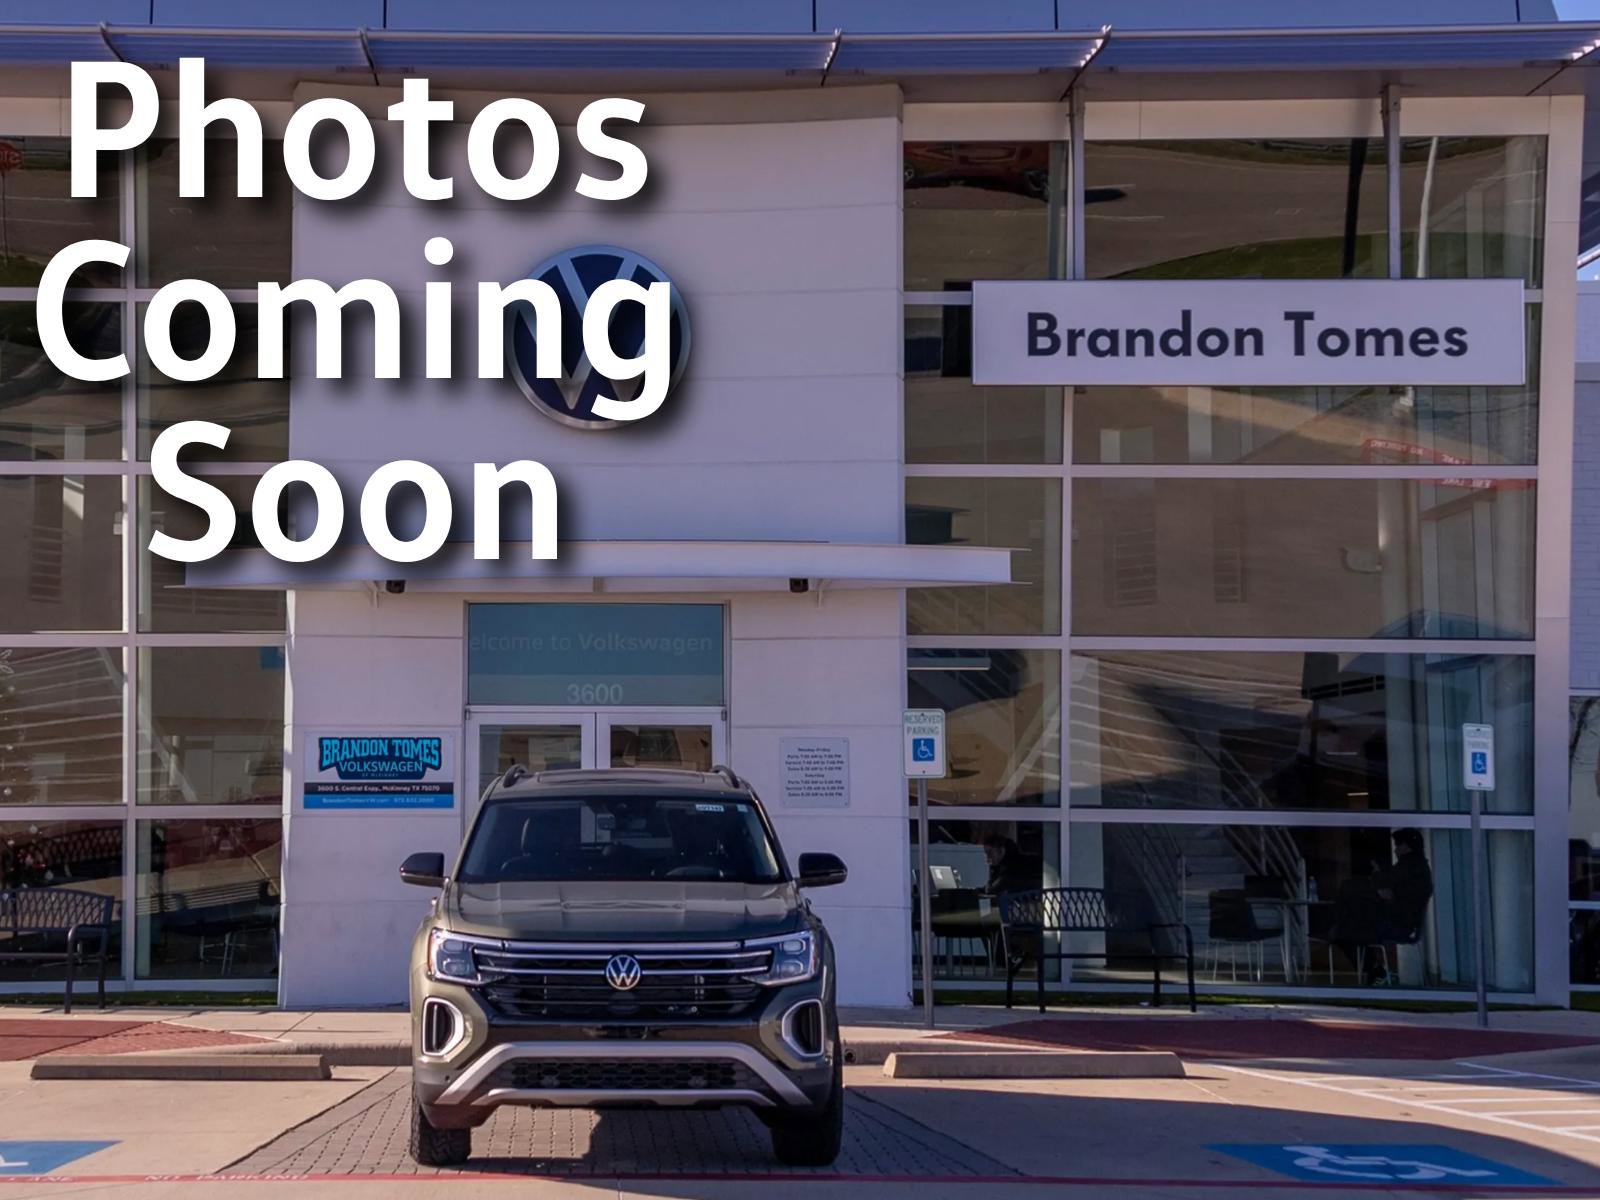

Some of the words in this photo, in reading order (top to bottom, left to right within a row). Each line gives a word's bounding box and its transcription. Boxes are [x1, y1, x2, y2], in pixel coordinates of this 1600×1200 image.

[1027, 309, 1265, 358] Brandon
[1284, 310, 1469, 358] Tomes
[470, 633, 544, 651] elcome
[552, 634, 572, 651] to
[579, 633, 713, 656] Volkswagen
[567, 683, 624, 704] 3600
[907, 726, 940, 736] PARKING
[322, 738, 389, 768] BRANDON
[392, 738, 440, 768] TOMES
[339, 761, 423, 773] VOLKSWAGEN
